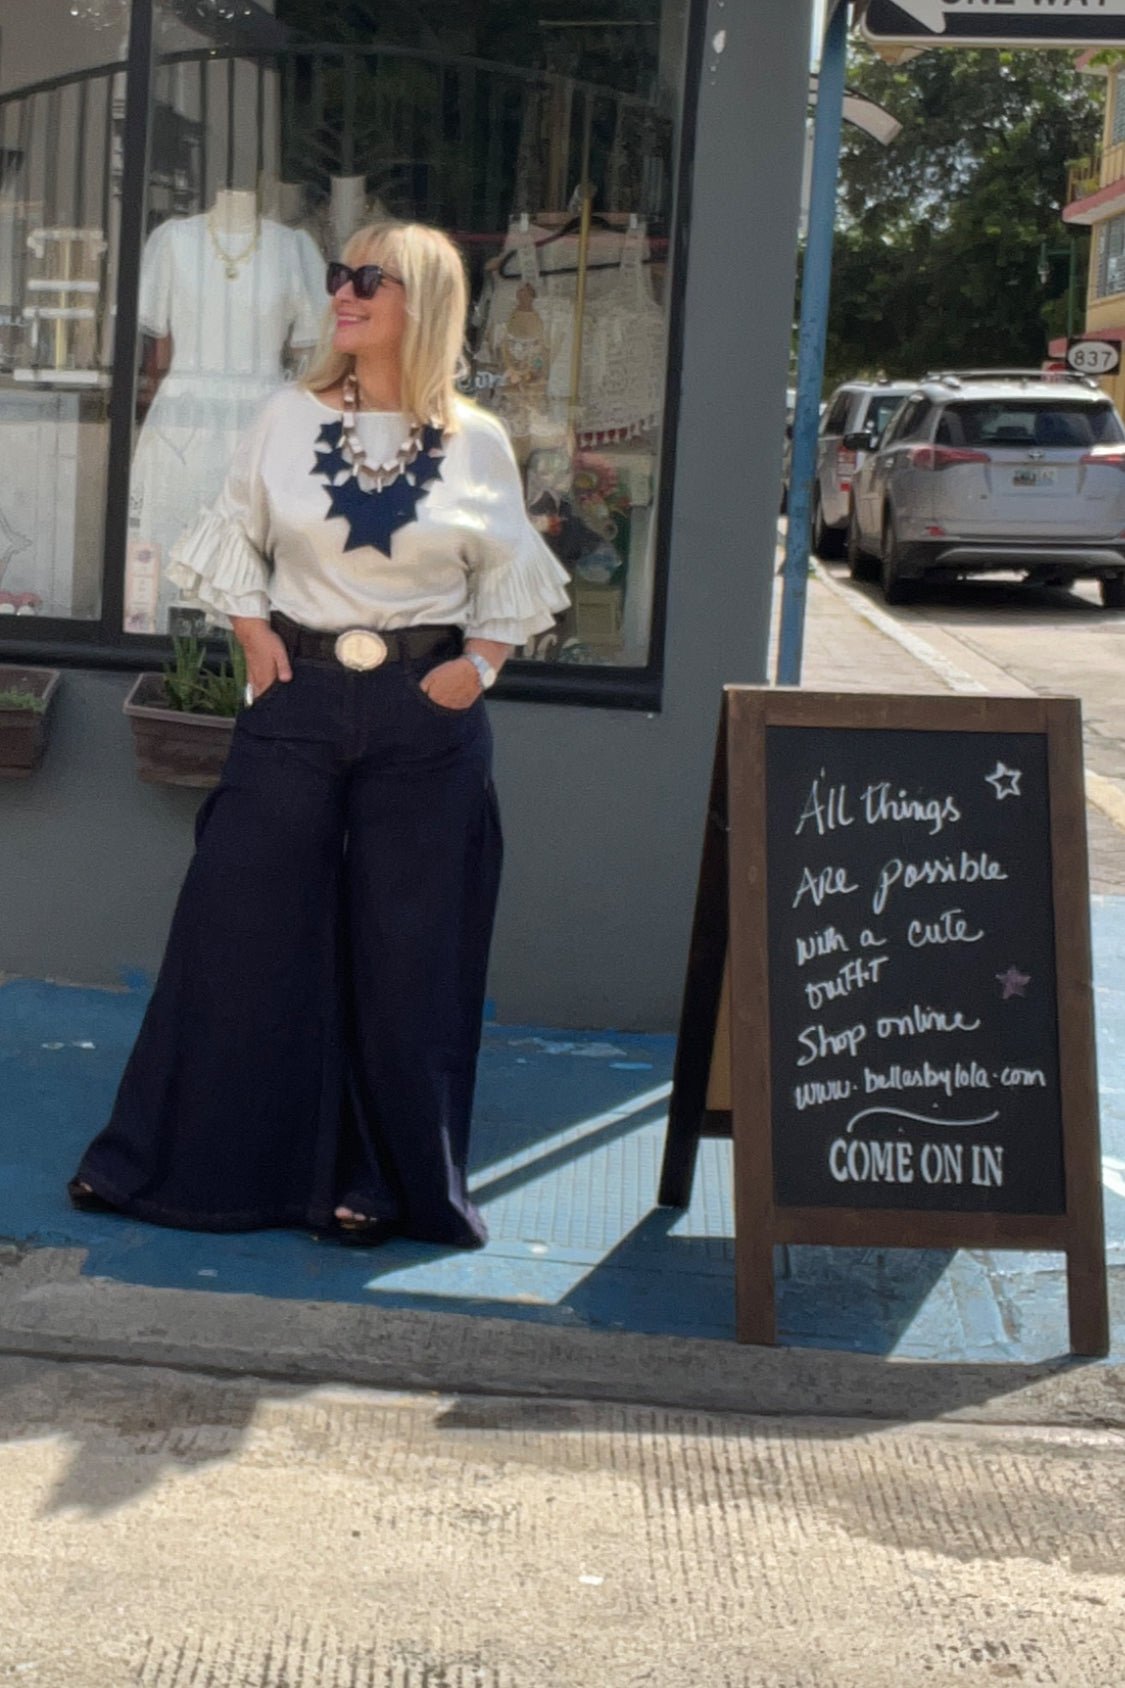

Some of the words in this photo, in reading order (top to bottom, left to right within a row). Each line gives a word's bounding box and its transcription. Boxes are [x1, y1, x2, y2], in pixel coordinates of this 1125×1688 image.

[1073, 350, 1112, 368] 837
[796, 778, 853, 835] All
[860, 782, 961, 836] things
[872, 851, 1008, 915] possible
[796, 925, 850, 966] with
[860, 929, 887, 947] a
[908, 908, 984, 948] cute
[796, 1024, 867, 1066] Shop
[877, 1004, 981, 1038] online
[829, 1138, 914, 1183] COME
[920, 1143, 963, 1184] ON
[971, 1145, 1004, 1187] IN
